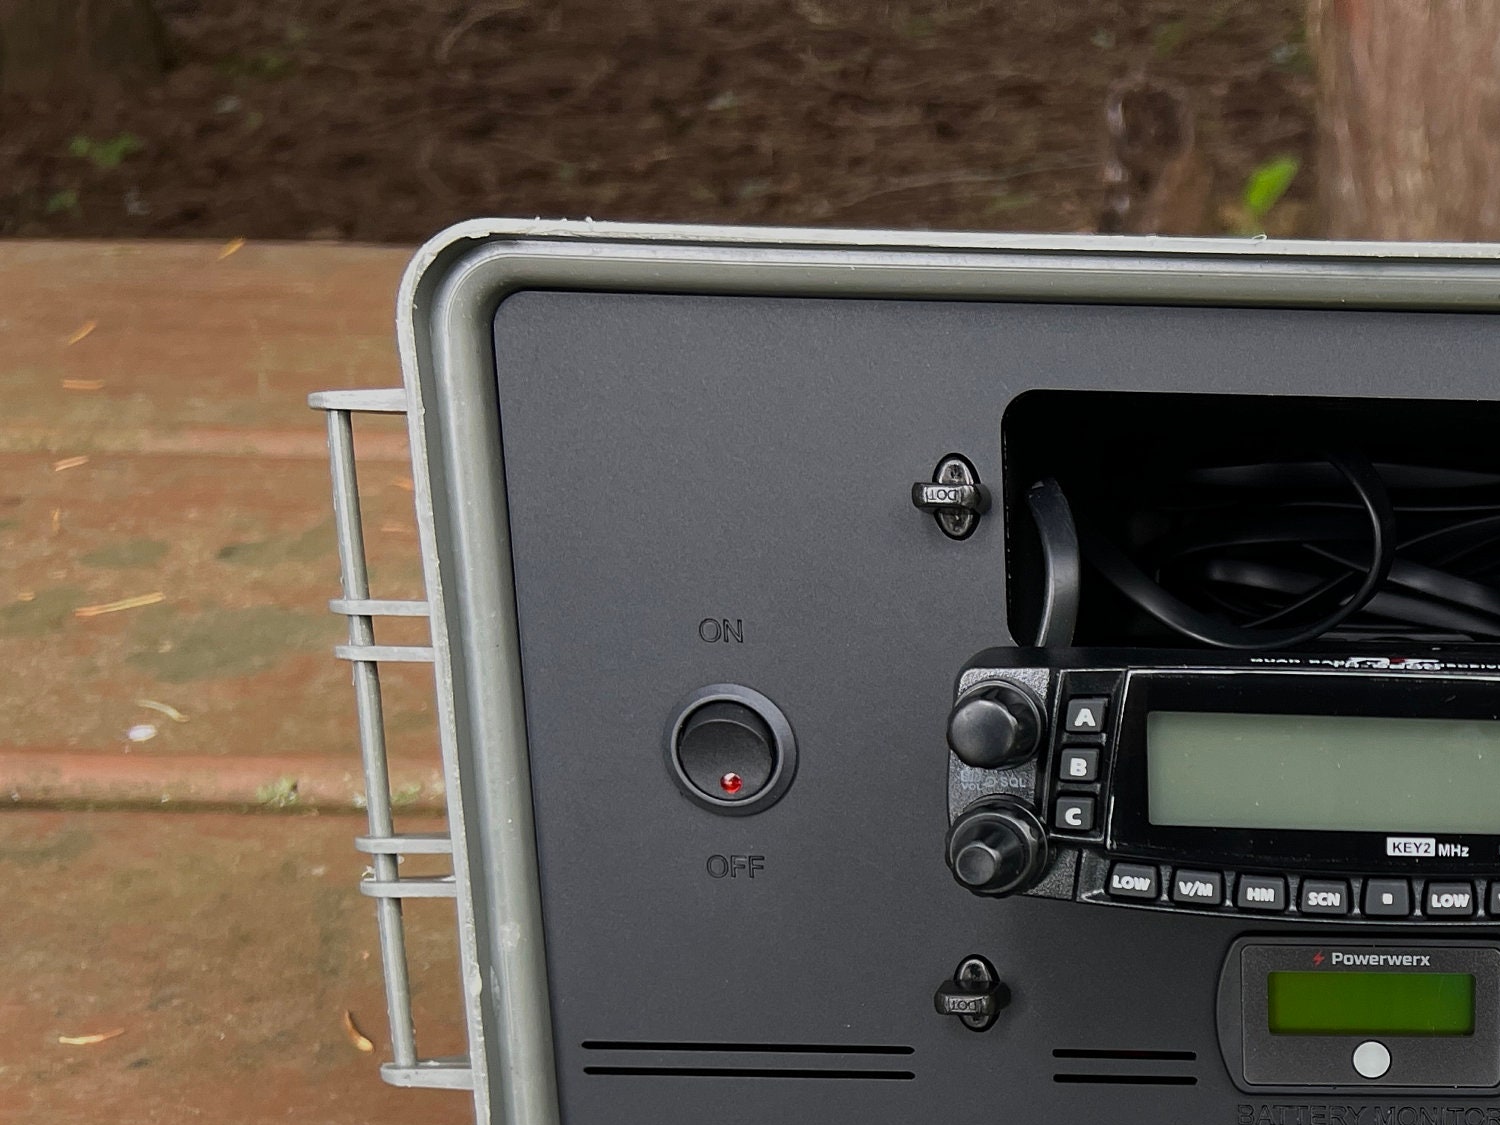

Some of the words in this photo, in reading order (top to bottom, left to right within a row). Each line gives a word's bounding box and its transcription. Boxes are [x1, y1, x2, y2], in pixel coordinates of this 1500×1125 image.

[698, 618, 744, 643] ON
[1074, 708, 1096, 727] A
[1069, 757, 1088, 777] B
[1064, 807, 1082, 826] C
[1391, 841, 1432, 854] KEY2
[1438, 843, 1470, 857] MHz
[706, 854, 765, 878] OFF
[1112, 874, 1151, 891] LOW
[1178, 880, 1214, 898] V/M
[1246, 887, 1275, 902] HM
[1307, 891, 1341, 907] SCN
[1431, 893, 1470, 908] LOW
[1331, 952, 1431, 967] Powerwerx
